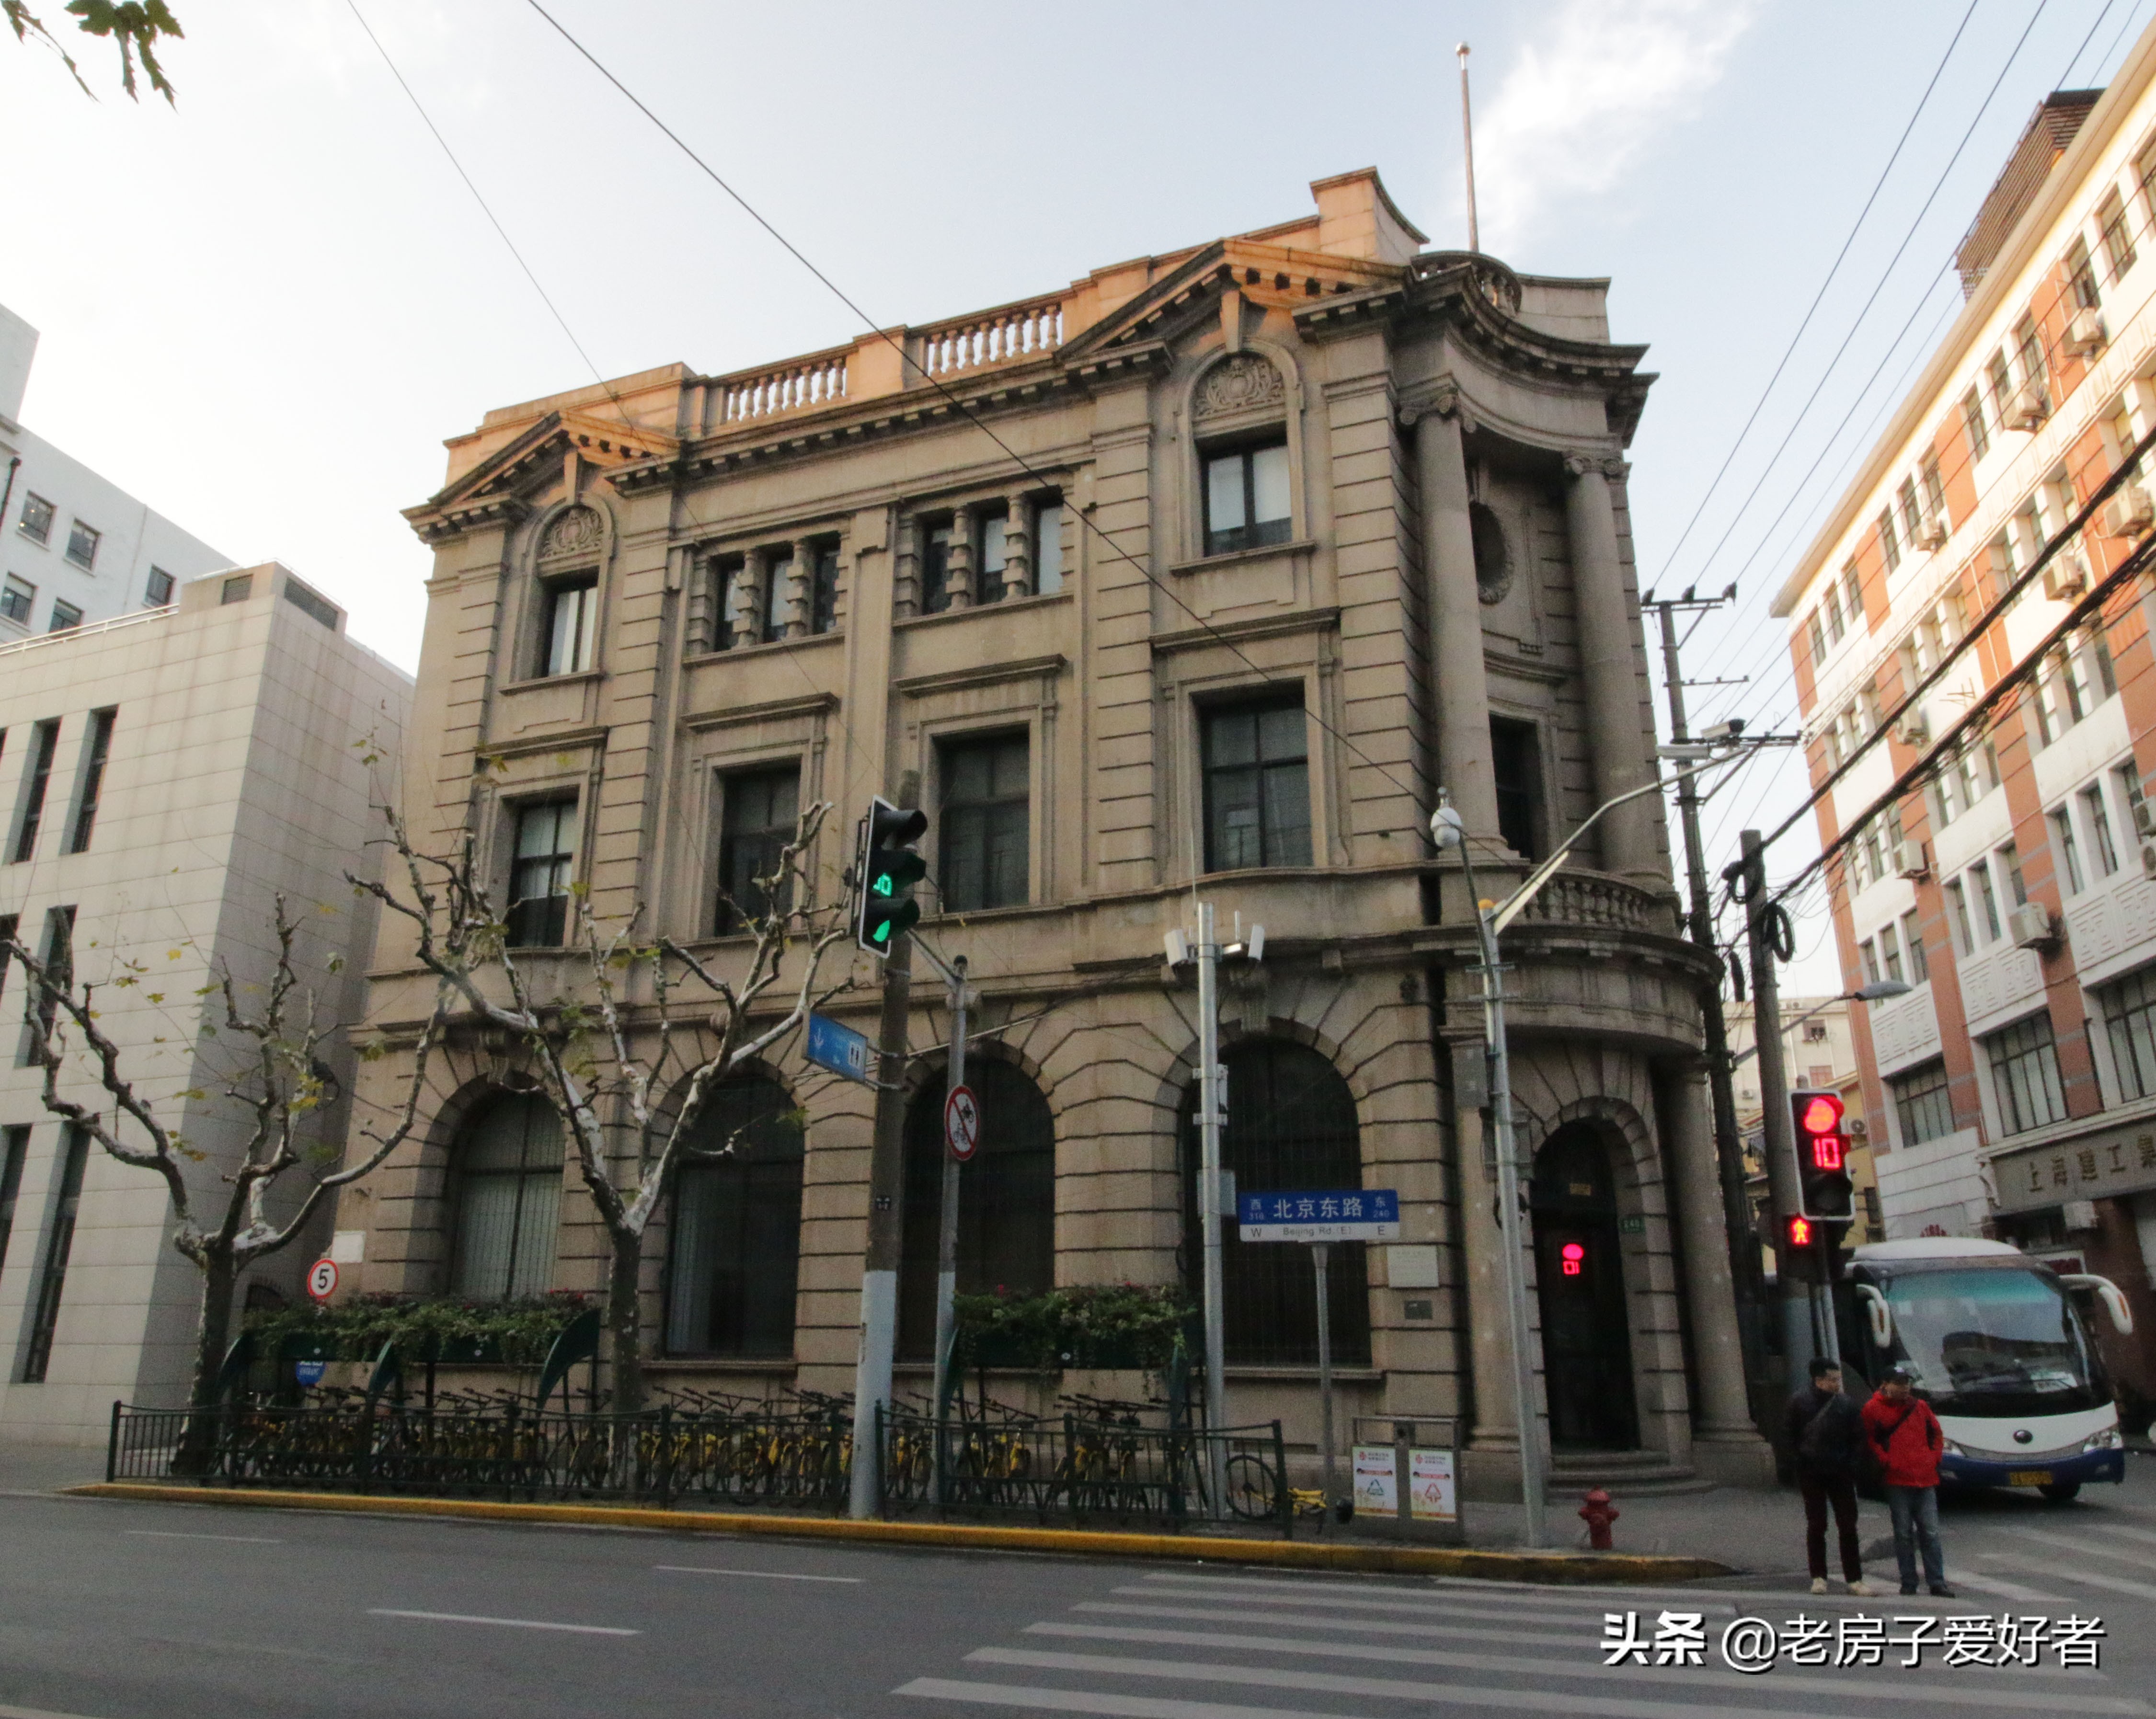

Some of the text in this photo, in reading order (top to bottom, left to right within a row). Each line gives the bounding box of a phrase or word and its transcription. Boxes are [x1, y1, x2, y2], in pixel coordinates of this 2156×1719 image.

[1814, 1137, 1841, 1169] 10
[1273, 1197, 1363, 1219] 北京东路
[1251, 1228, 1261, 1237] W
[1283, 1227, 1314, 1237] Beijing
[1377, 1226, 1386, 1235] E
[318, 1268, 330, 1289] 5
